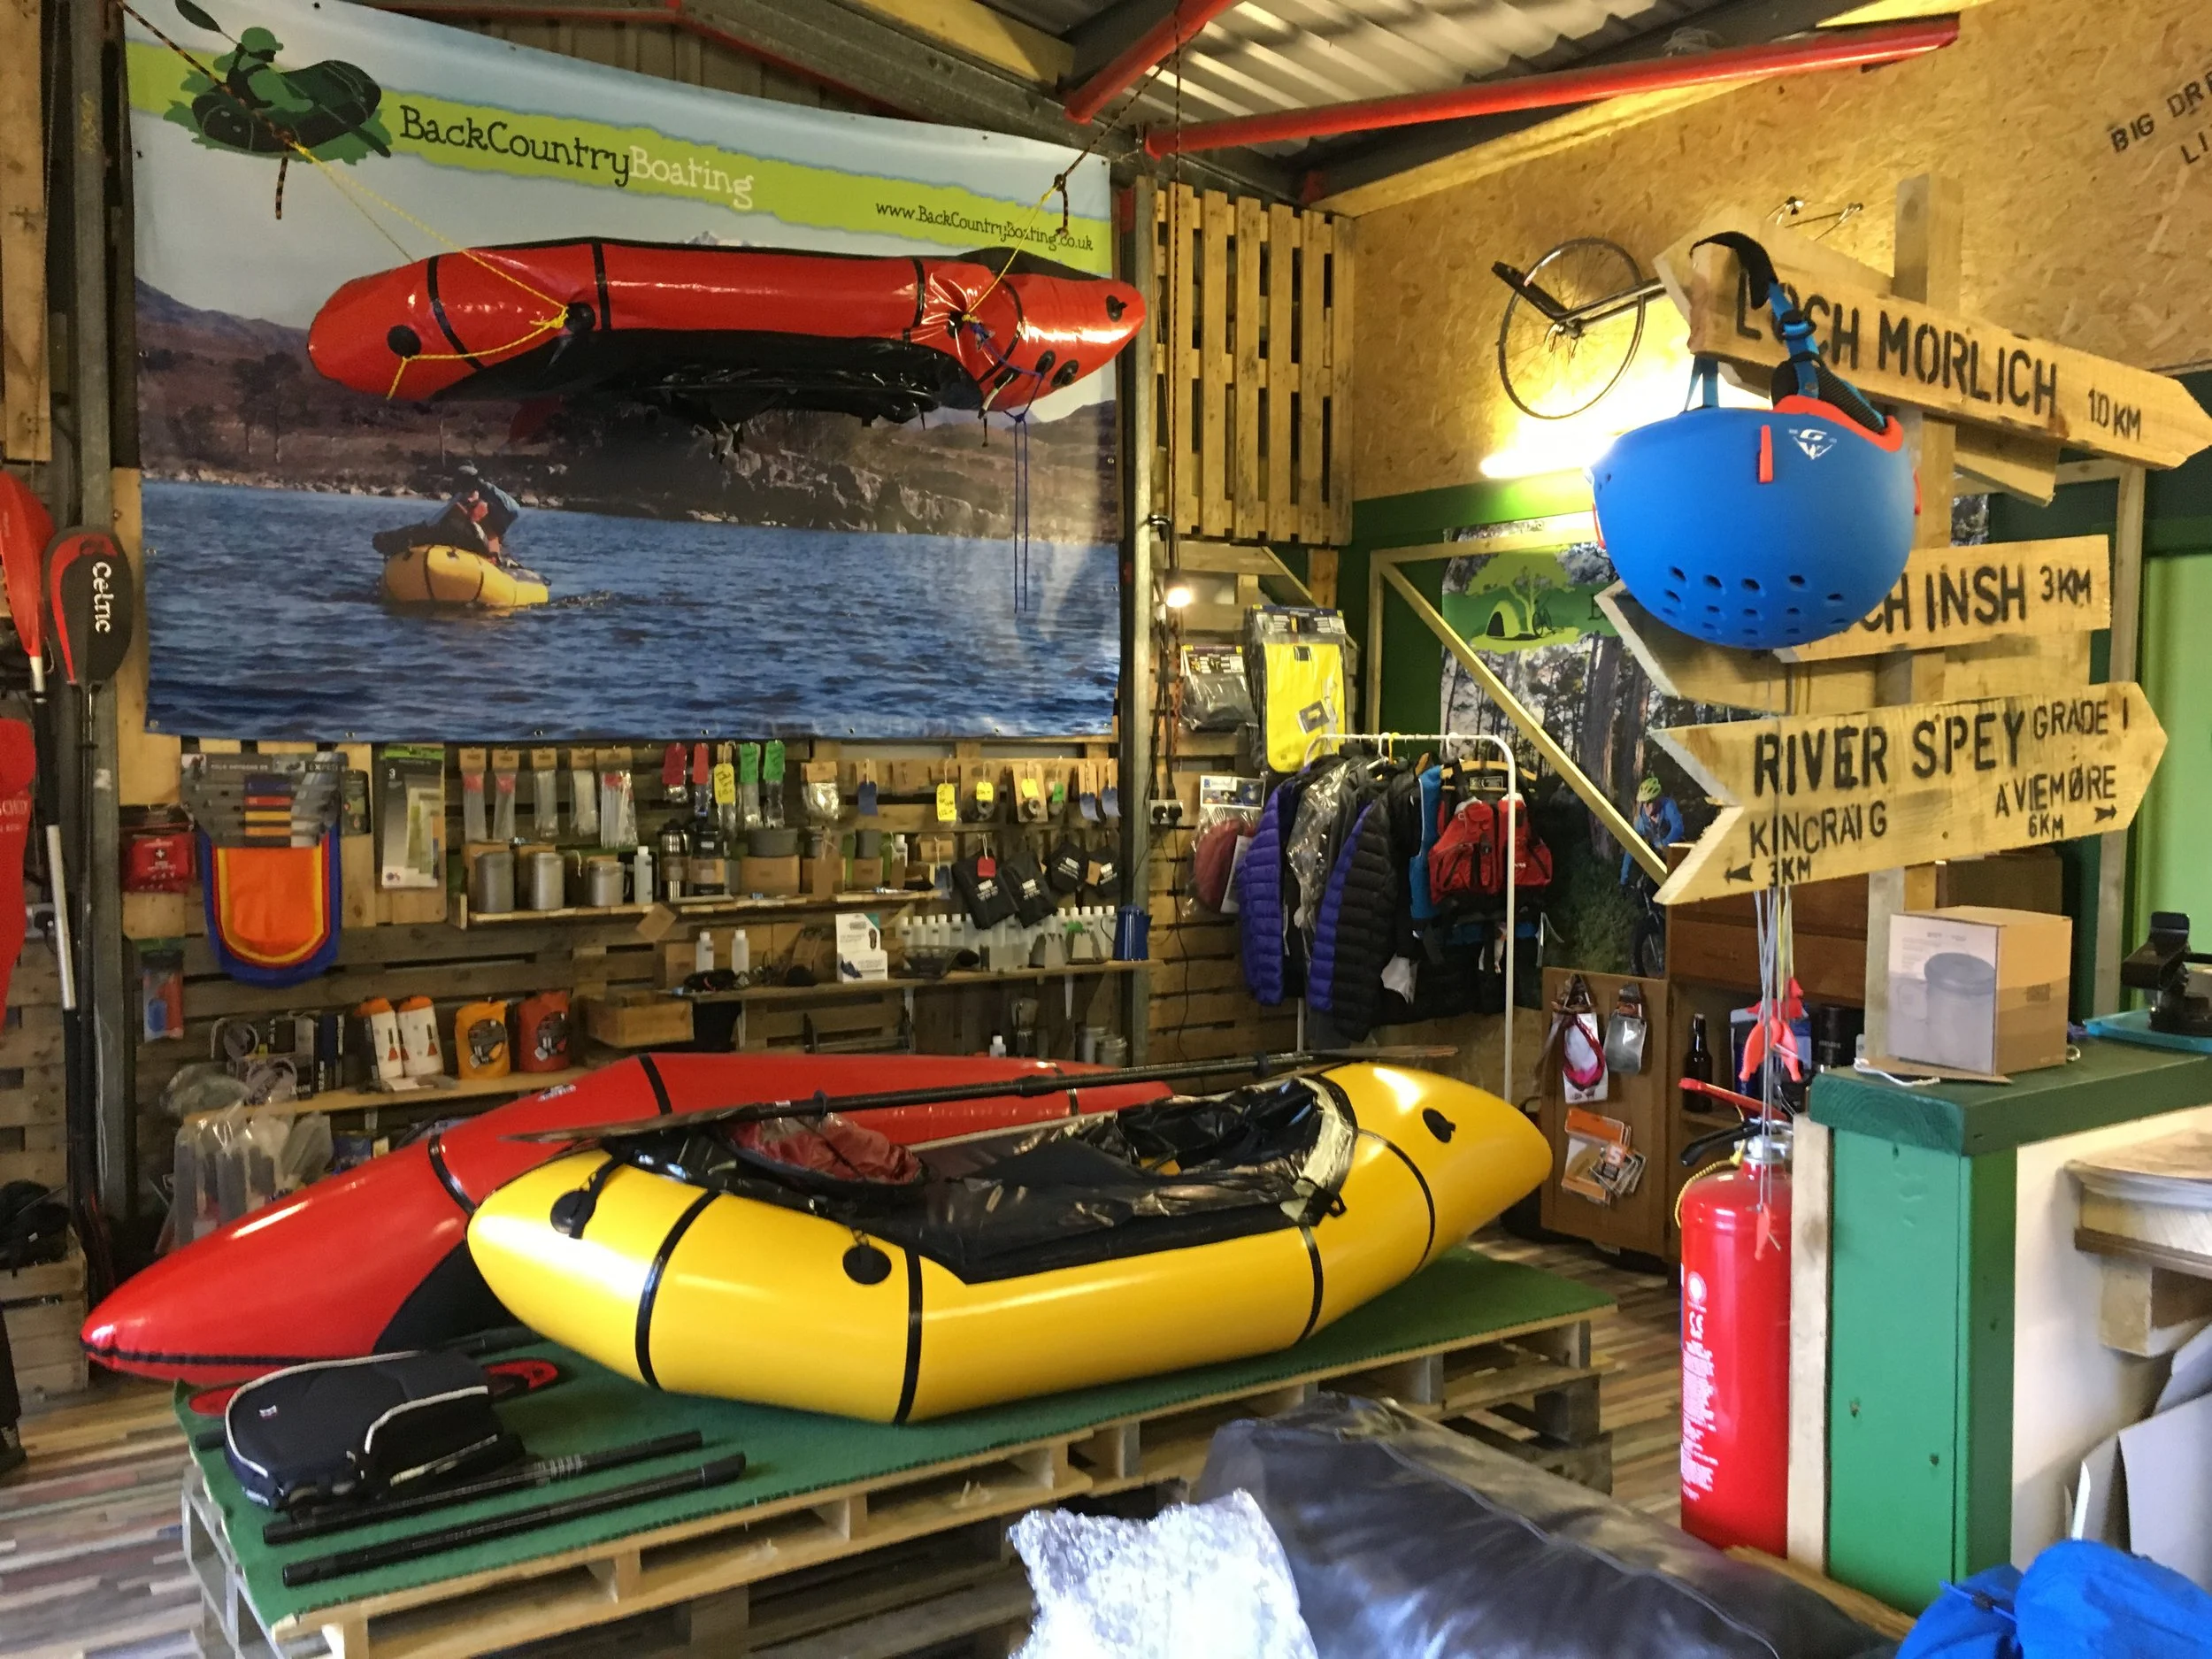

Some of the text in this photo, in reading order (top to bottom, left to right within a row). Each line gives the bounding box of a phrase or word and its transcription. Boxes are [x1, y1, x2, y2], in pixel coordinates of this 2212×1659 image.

[2110, 112, 2154, 153] BIG
[875, 203, 1094, 251] www.BackCountryBoating.co.uk
[1878, 310, 2057, 419] MORLICH
[1925, 564, 2027, 634] INSH
[1755, 725, 1888, 797] RIVER
[1912, 710, 2025, 780] SPEY
[2033, 699, 2109, 741] GRADE
[1749, 800, 1888, 859] KINCRAIG
[2028, 812, 2064, 840] 6KM
